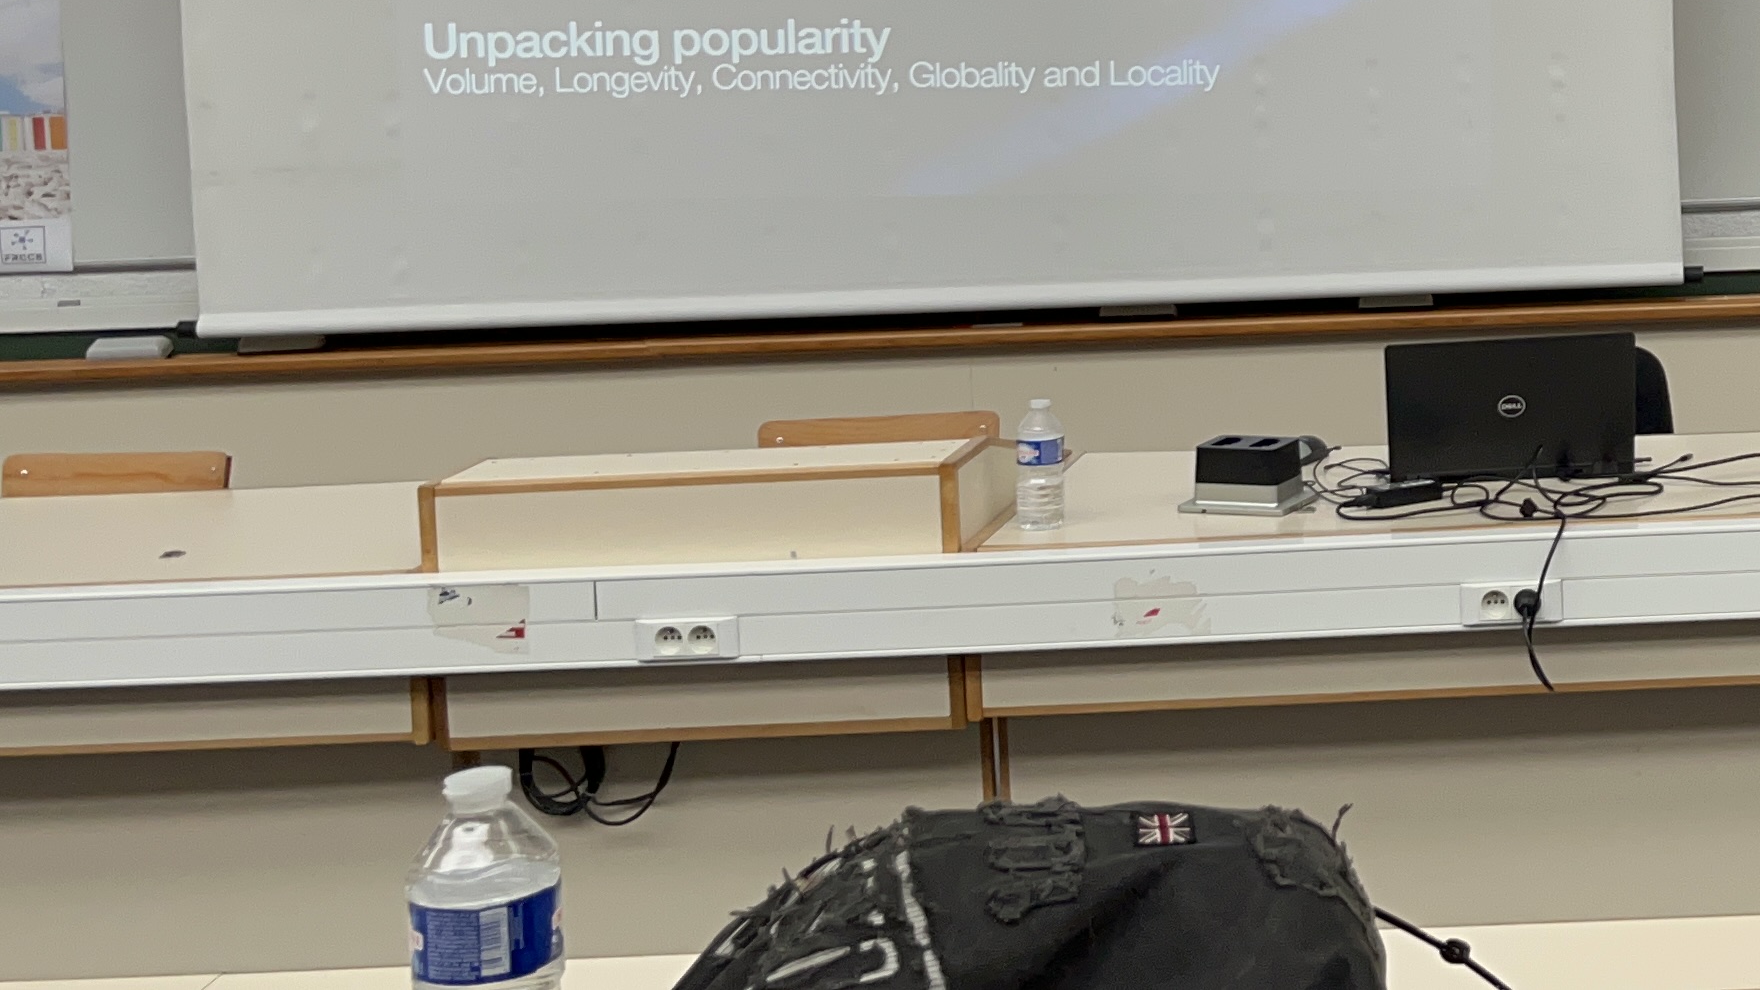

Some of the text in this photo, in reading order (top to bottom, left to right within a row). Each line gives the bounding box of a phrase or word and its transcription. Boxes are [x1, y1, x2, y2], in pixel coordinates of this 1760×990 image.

[424, 18, 891, 67] Unpacking popularity
[423, 59, 1220, 99] Volume, Longevity, Connectivity, Globality and Locality
